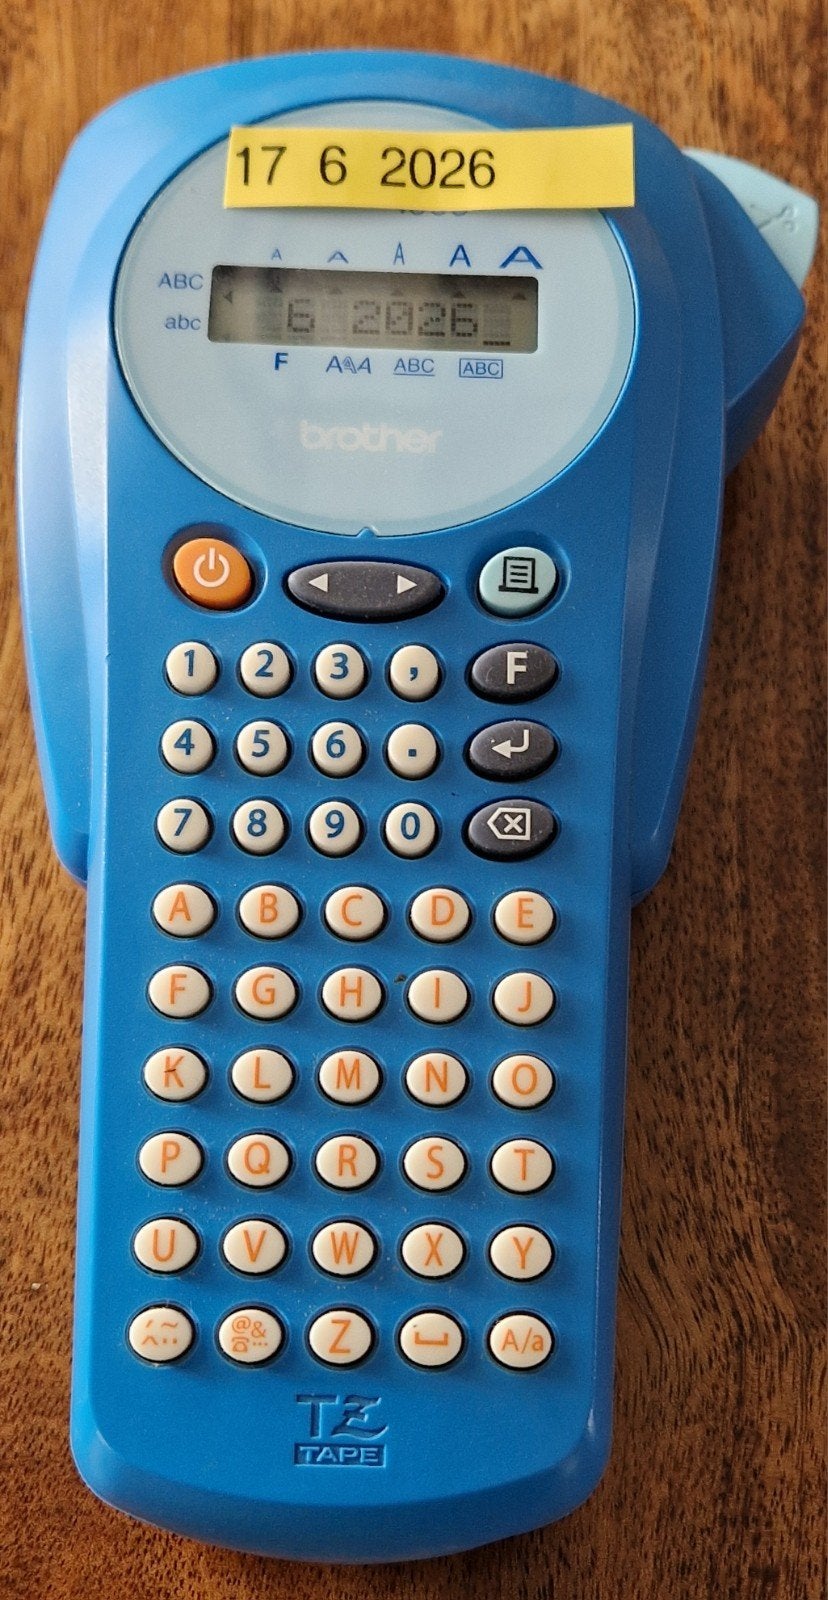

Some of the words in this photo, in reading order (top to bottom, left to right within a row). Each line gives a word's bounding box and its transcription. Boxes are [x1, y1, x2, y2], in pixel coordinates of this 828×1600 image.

[236, 146, 286, 185] 17
[320, 147, 347, 185] 6
[380, 148, 495, 189] 2026
[271, 249, 282, 260] A
[328, 251, 348, 263] A
[394, 242, 404, 264] A
[449, 245, 471, 267] A
[500, 246, 544, 269] A
[159, 274, 203, 290] ABC
[165, 315, 201, 331] abc
[287, 300, 315, 335] 6
[352, 301, 478, 337] 2026
[275, 353, 288, 370] F
[394, 358, 435, 374] ABC
[463, 360, 500, 376] ABC
[300, 421, 442, 453] brother
[185, 650, 194, 676] 1
[255, 650, 273, 678] 2
[331, 653, 348, 680] 3
[507, 651, 528, 684] F
[174, 728, 194, 756] 4
[252, 730, 270, 757] 5
[326, 731, 345, 758] 6
[174, 808, 192, 836] 7
[247, 809, 267, 836] 8
[325, 810, 344, 838] 9
[401, 811, 420, 840] 0
[169, 891, 191, 921] A
[260, 893, 278, 923] B
[341, 895, 363, 926] C
[430, 896, 455, 926] D
[517, 898, 533, 928] E
[169, 973, 187, 1004] F
[252, 975, 275, 1005] G
[340, 976, 362, 1007] H
[435, 978, 440, 1008] I
[517, 981, 532, 1012] J
[164, 1056, 184, 1088] K
[254, 1057, 271, 1089] L
[336, 1058, 360, 1089] M
[426, 1061, 447, 1092] N
[512, 1063, 538, 1095] O
[162, 1141, 180, 1173] P
[244, 1142, 270, 1175] Q
[339, 1145, 356, 1176] R
[427, 1146, 443, 1179] S
[514, 1149, 534, 1180] T
[152, 1230, 174, 1261] U
[243, 1230, 266, 1262] V
[330, 1232, 359, 1265] W
[424, 1233, 443, 1266] X
[512, 1237, 532, 1269] Y
[330, 1320, 350, 1353] Z
[501, 1328, 544, 1354] A/a
[300, 1446, 379, 1463] TAPE
